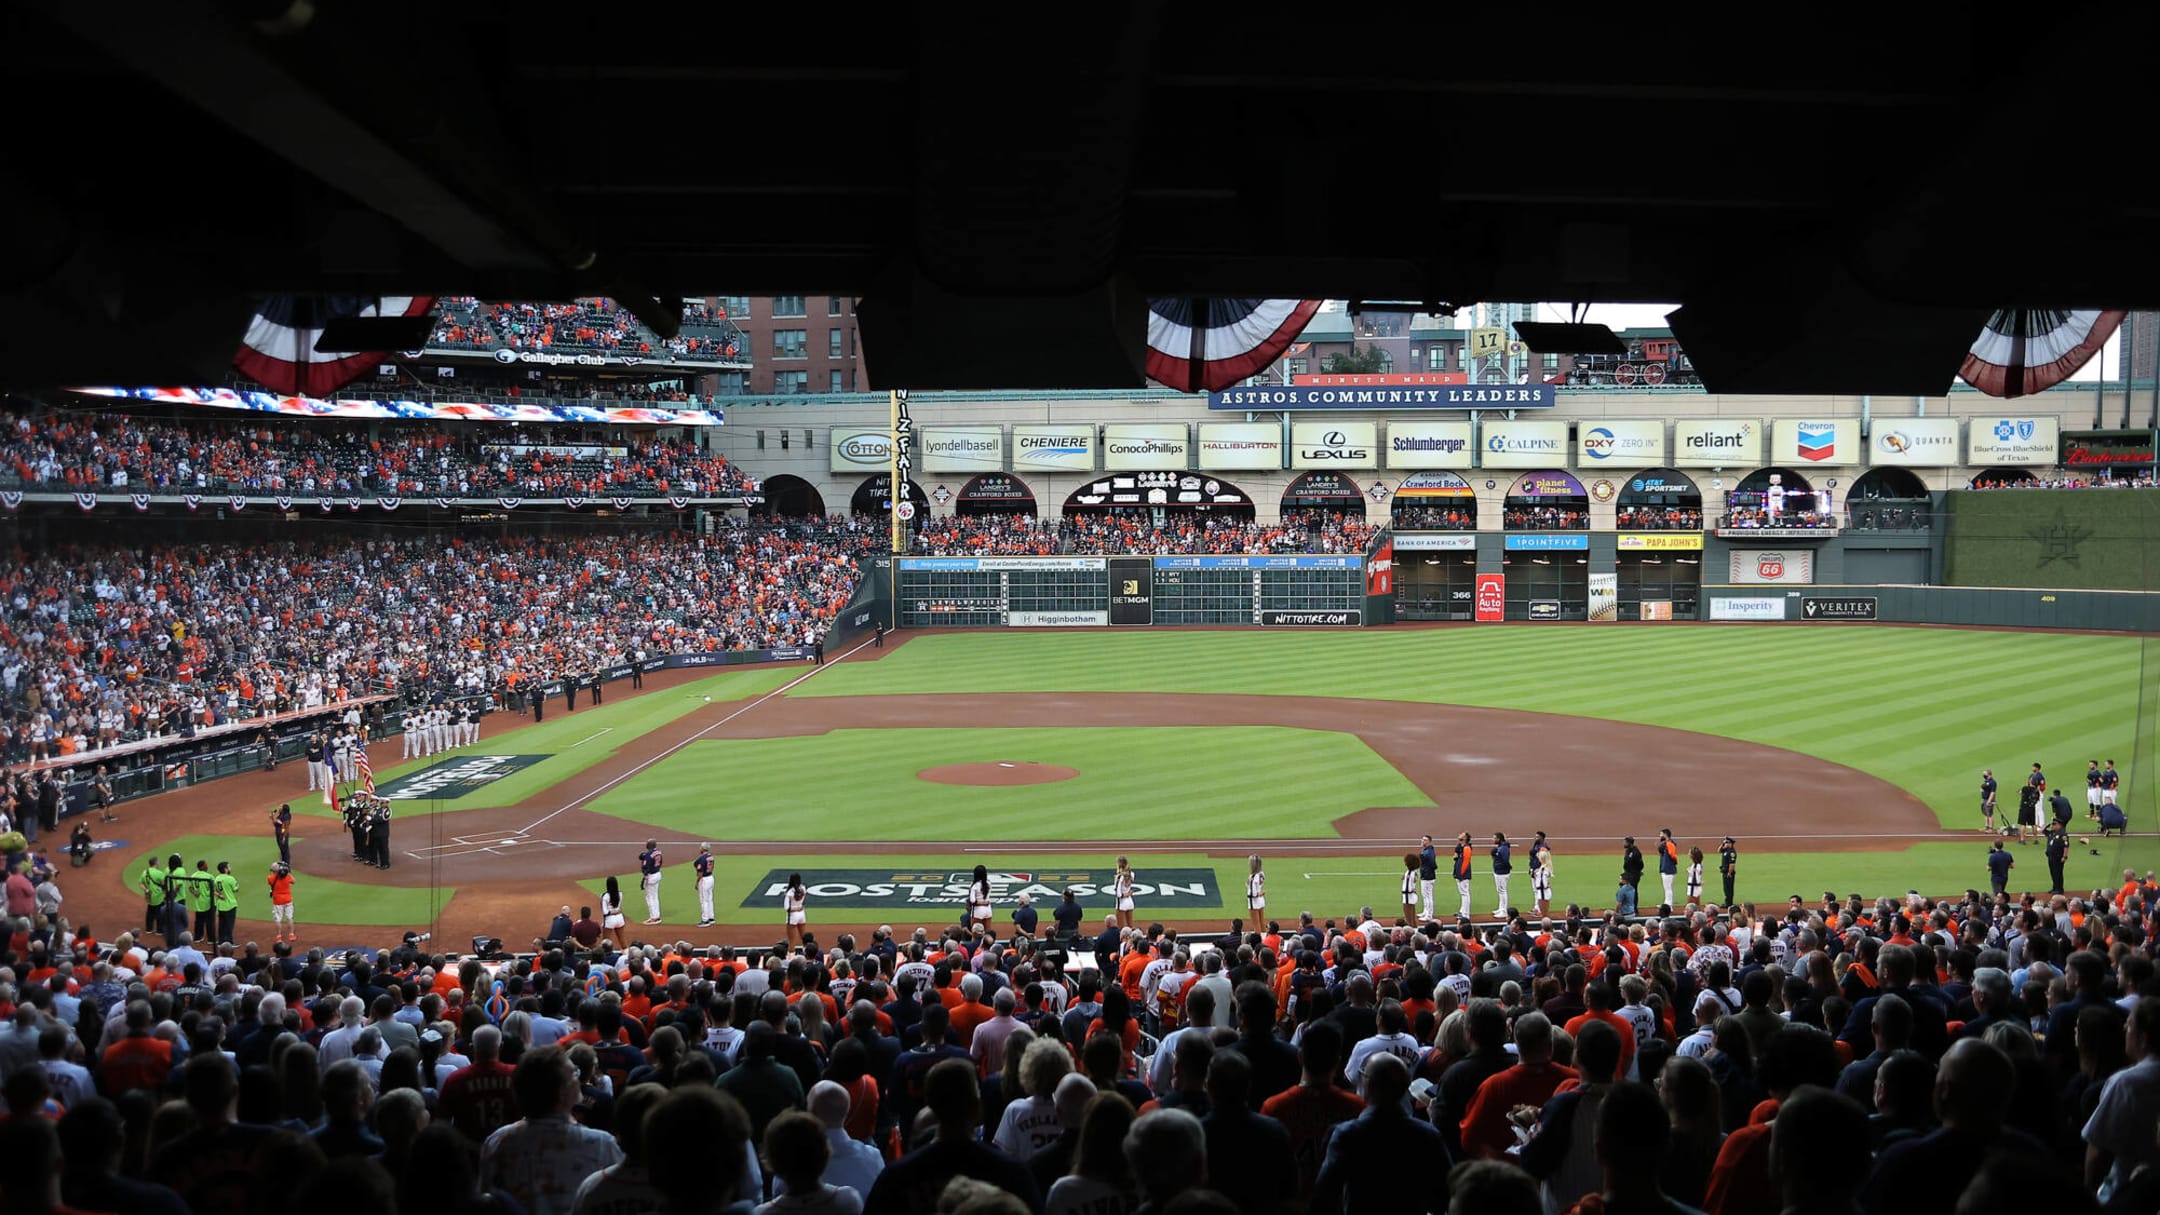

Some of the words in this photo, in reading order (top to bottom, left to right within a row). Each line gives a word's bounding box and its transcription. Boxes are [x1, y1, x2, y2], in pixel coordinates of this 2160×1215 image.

[1479, 333, 1497, 348] 17
[520, 352, 577, 365] Gallagher
[578, 354, 606, 365] Club
[1308, 391, 1439, 403] COMMUNITY
[1449, 390, 1542, 401] LEADERS
[1798, 422, 1835, 430] Chevron
[1020, 437, 1088, 448] CHENIERE
[1507, 439, 1558, 449] CALPINE
[1584, 439, 1615, 448] OXY
[1620, 440, 1643, 448] ZERO
[1686, 432, 1743, 447] reliant
[1915, 437, 1953, 446] QUANTA
[926, 439, 999, 453] lyondellbasell
[1109, 443, 1183, 456] ConocoPhillips
[1202, 442, 1278, 450] HALLIBURTON
[1393, 437, 1465, 453] Schlumberger
[1973, 445, 2011, 453] BlueCross
[2012, 445, 2053, 453] BlueShield
[1302, 450, 1367, 459] LEXUS
[2065, 448, 2154, 465] Budweiser
[898, 438, 911, 499] FAIR
[1405, 479, 1442, 488] Crawford
[1443, 479, 1464, 488] Bock
[1536, 479, 1566, 488] planet
[1540, 486, 1572, 494] fitness
[1646, 538, 1667, 547] PAPA
[1668, 538, 1698, 547] JOHN'S
[875, 560, 891, 568] 315
[1761, 564, 1779, 574] 66
[1452, 591, 1471, 599] 366
[1590, 588, 1615, 596] WM
[1112, 596, 1149, 604] BETMGM
[1479, 598, 1501, 607] Auto
[1728, 600, 1773, 612] Insperity
[1820, 602, 1871, 611] VERITEX
[1037, 615, 1096, 625] Higginbotham
[1275, 612, 1347, 624] NITTOTIRE.COM
[690, 656, 707, 664] MLB
